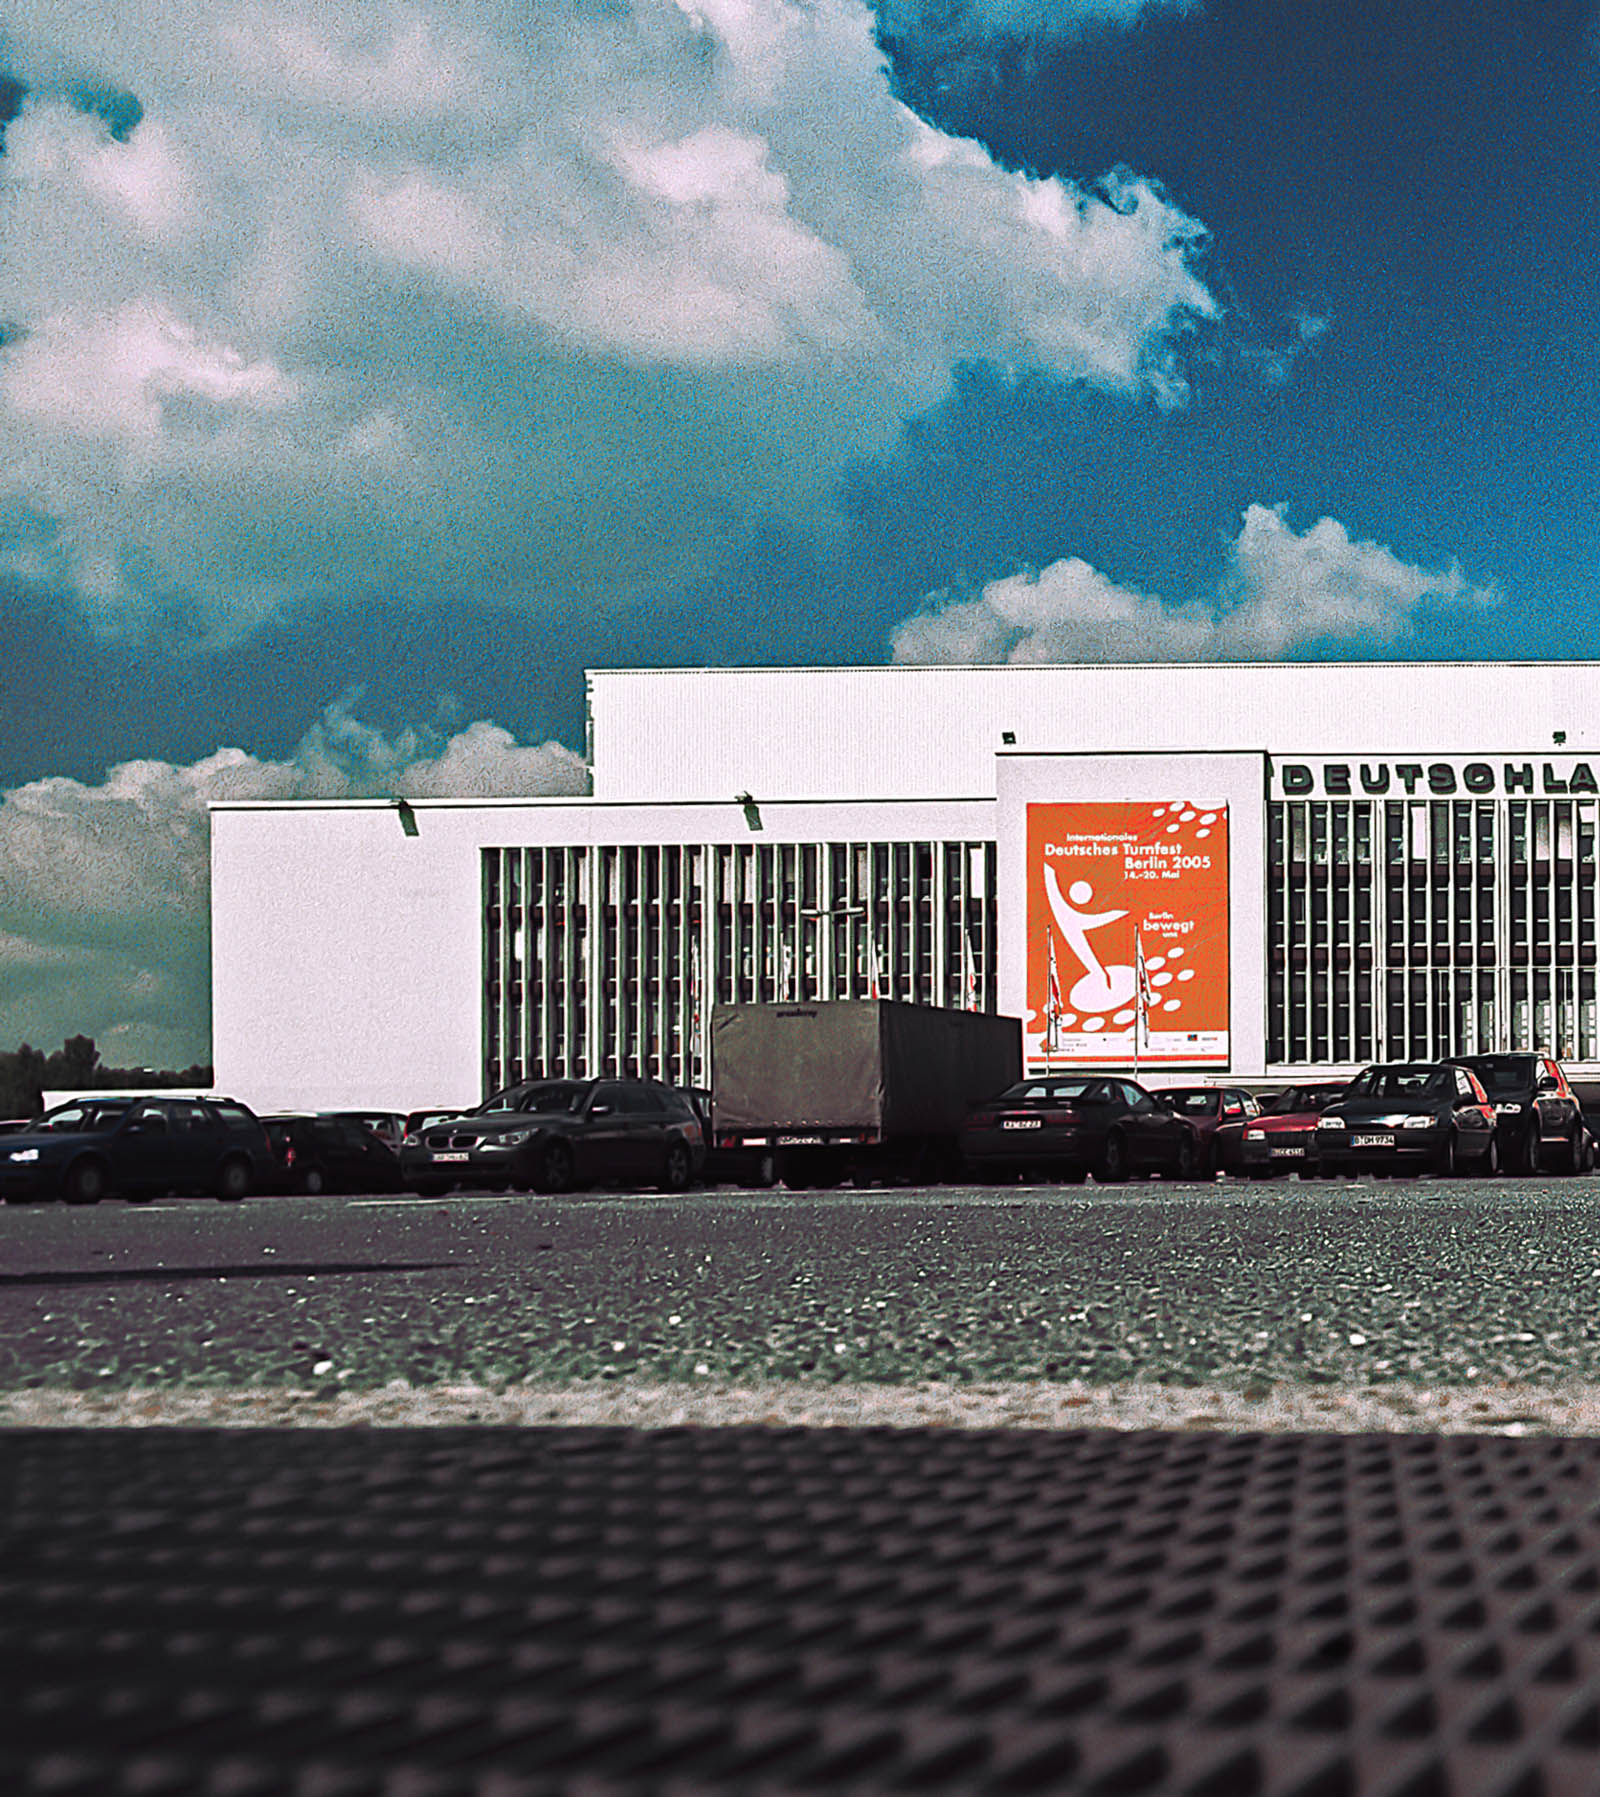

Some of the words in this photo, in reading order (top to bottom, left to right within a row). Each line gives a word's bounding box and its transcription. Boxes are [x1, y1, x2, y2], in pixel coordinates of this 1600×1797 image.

[1066, 832, 1138, 842] Internationales
[1044, 842, 1119, 856] Deutsches
[1123, 841, 1182, 855] Turnfest
[1124, 856, 1168, 869] Berlin
[1172, 855, 1211, 869] 2005
[1162, 870, 1180, 879] Mai
[1143, 918, 1195, 934] bewegt
